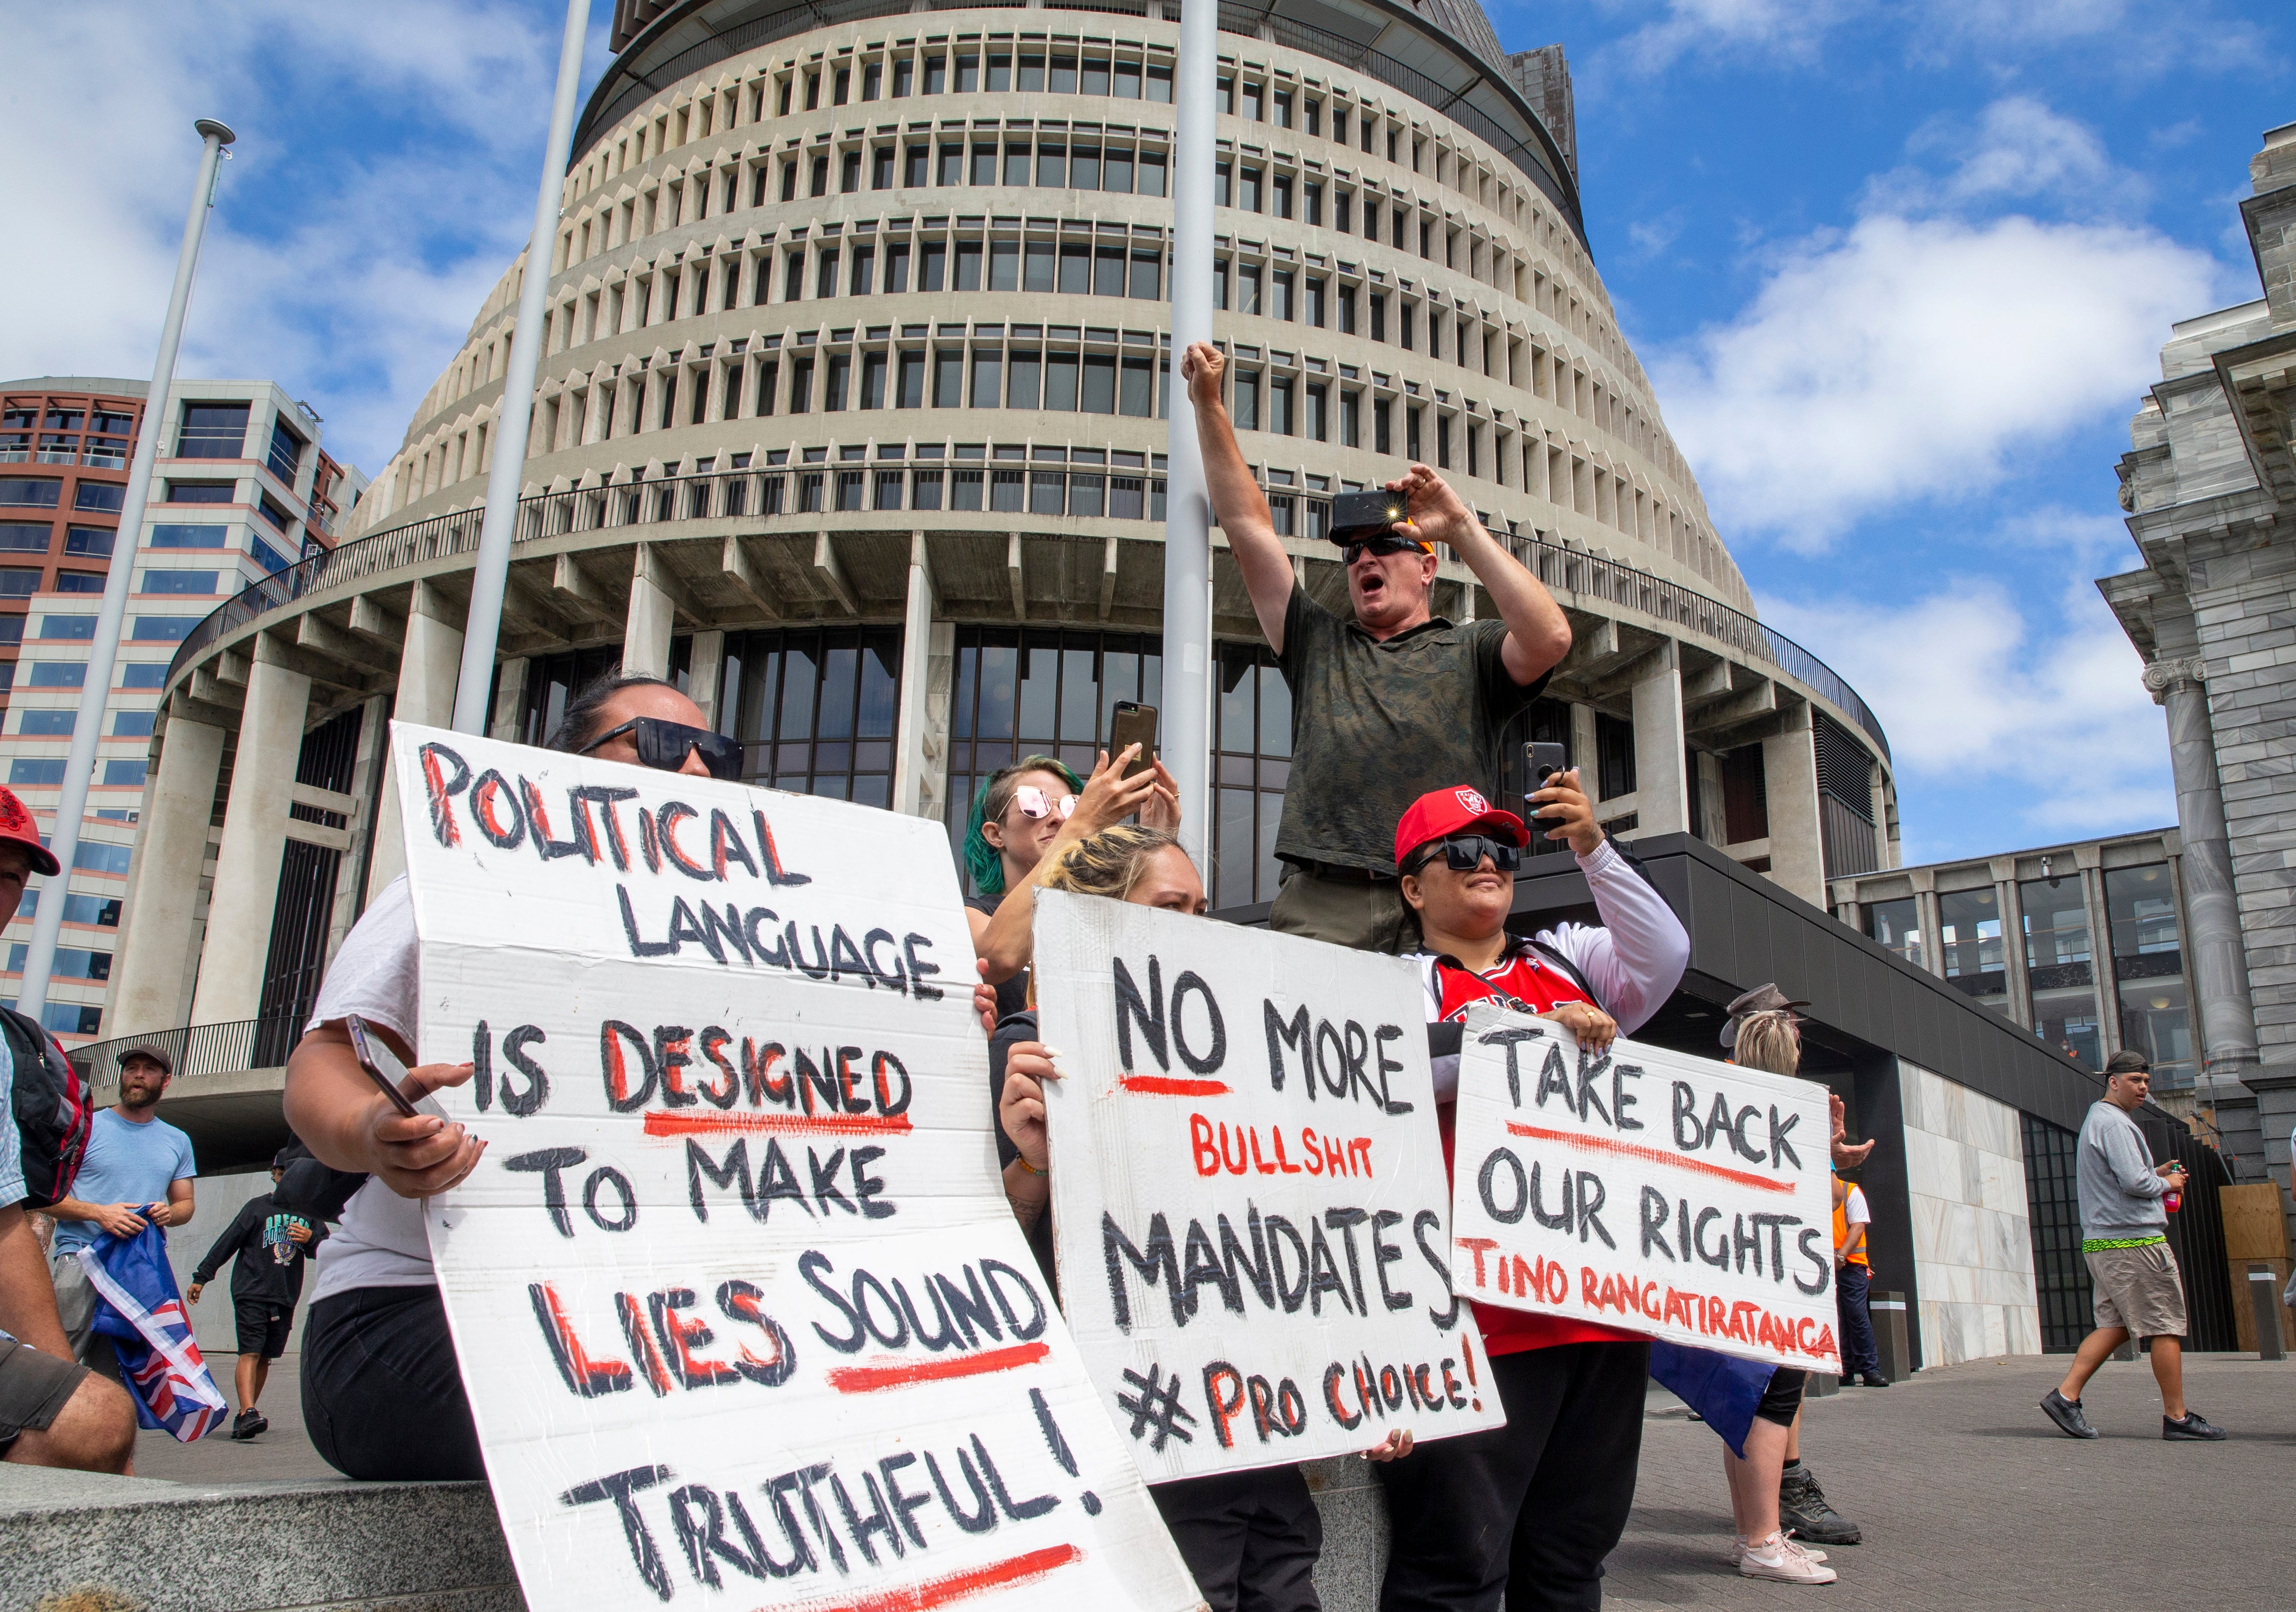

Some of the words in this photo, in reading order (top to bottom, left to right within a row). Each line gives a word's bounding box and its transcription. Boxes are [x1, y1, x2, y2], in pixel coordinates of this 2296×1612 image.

[419, 742, 812, 888] POLITICAL
[615, 883, 944, 1001] LANGUAGE
[473, 1019, 552, 1118] IS
[600, 1019, 912, 1116] DESIGNED
[1113, 954, 1227, 1076] NO
[1263, 998, 1415, 1116] MORE
[1478, 1027, 1645, 1133] TAKE
[1672, 1080, 1802, 1170] BACK
[502, 1146, 638, 1238] TO
[685, 1137, 898, 1225] MAKE
[1189, 1112, 1373, 1180] BULLSHIT
[1101, 1198, 1461, 1336] MANDATES
[1454, 1237, 1569, 1305] TINO
[1477, 1146, 1617, 1251] OUR
[1639, 1184, 1831, 1298] RIGHTS
[527, 1279, 798, 1399] LIES
[798, 1249, 1048, 1354] SOUND
[1321, 1331, 1484, 1432] CHOICE!
[558, 1386, 1102, 1603] TRUTHFUL!
